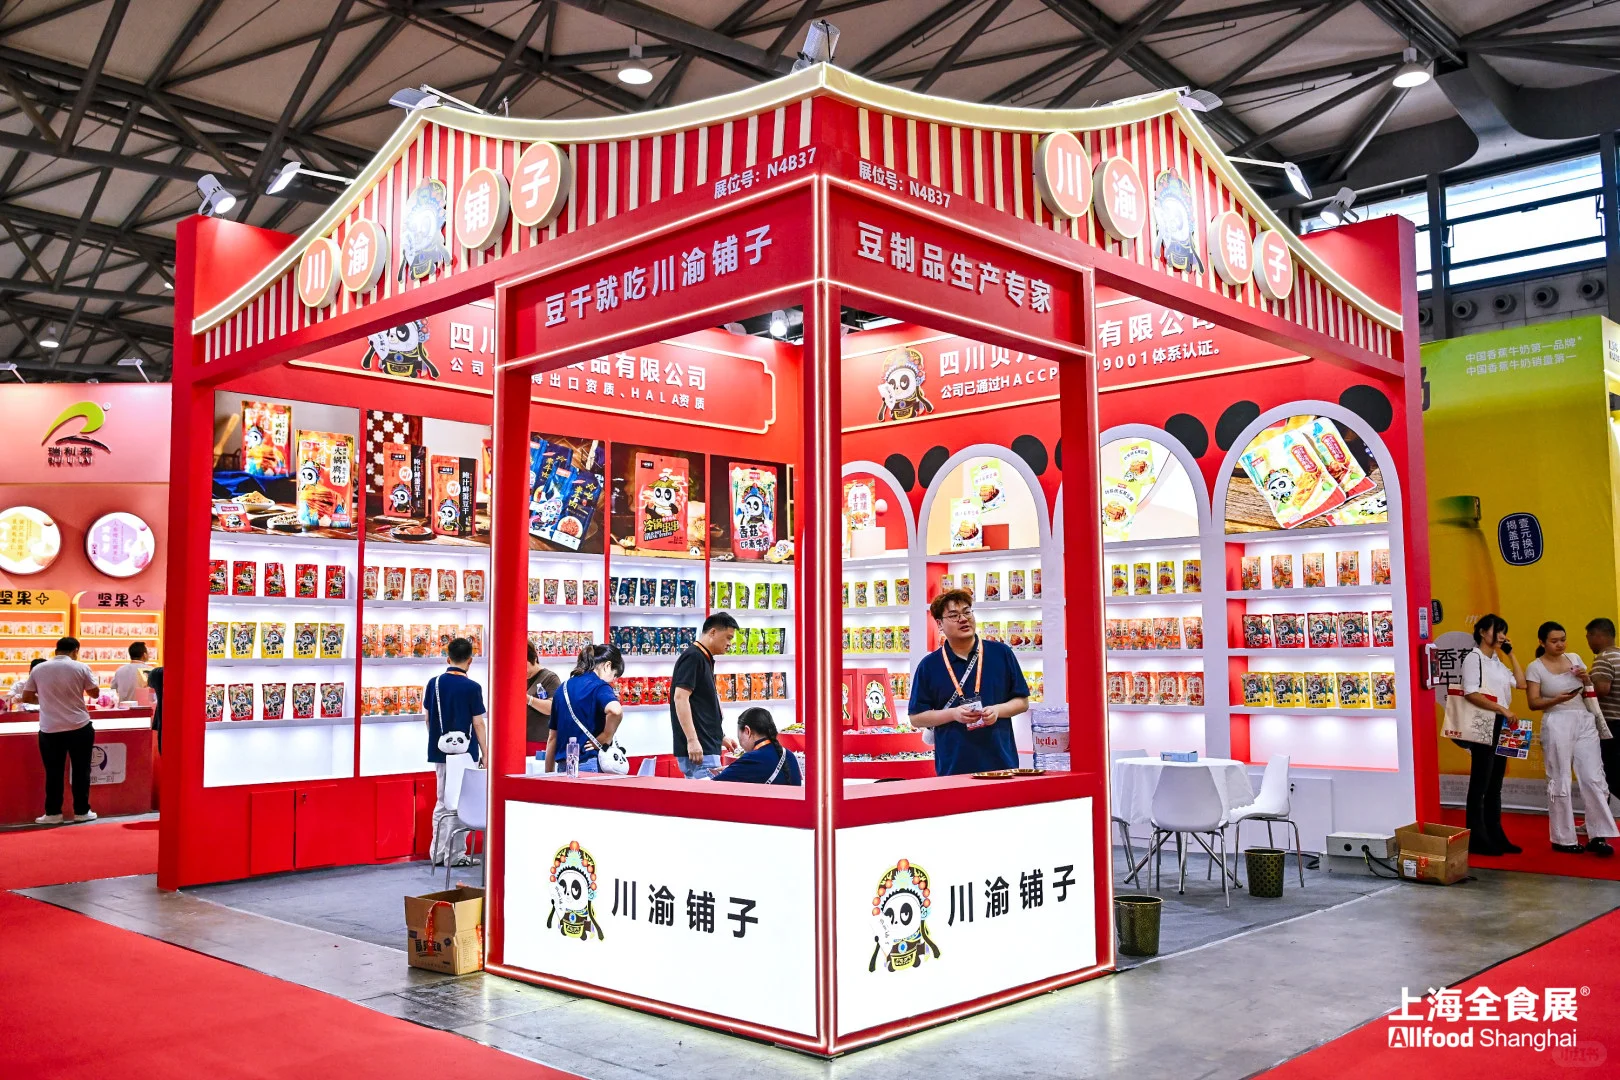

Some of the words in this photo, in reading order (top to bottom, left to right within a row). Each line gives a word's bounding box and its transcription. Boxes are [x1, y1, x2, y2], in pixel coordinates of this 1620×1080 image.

[767, 147, 817, 179] N4B37
[910, 180, 950, 209] N4B37
[545, 224, 772, 327] 豆干就吃川渝铺子
[858, 221, 1051, 312] 豆制品生产专家
[450, 357, 484, 376] 公司
[567, 352, 706, 391] 品有限公司
[939, 344, 1036, 377] 四川贝
[1097, 340, 1219, 371] 9001体系认证。
[1466, 353, 1577, 376] 中国香蕉牛奶销量第一
[739, 524, 759, 538] 香菇
[1506, 520, 1523, 561] 揭盖有礼
[1518, 518, 1535, 559] 壹元换购
[611, 878, 759, 938] 川渝铺子
[948, 864, 1076, 927] 川渝铺子
